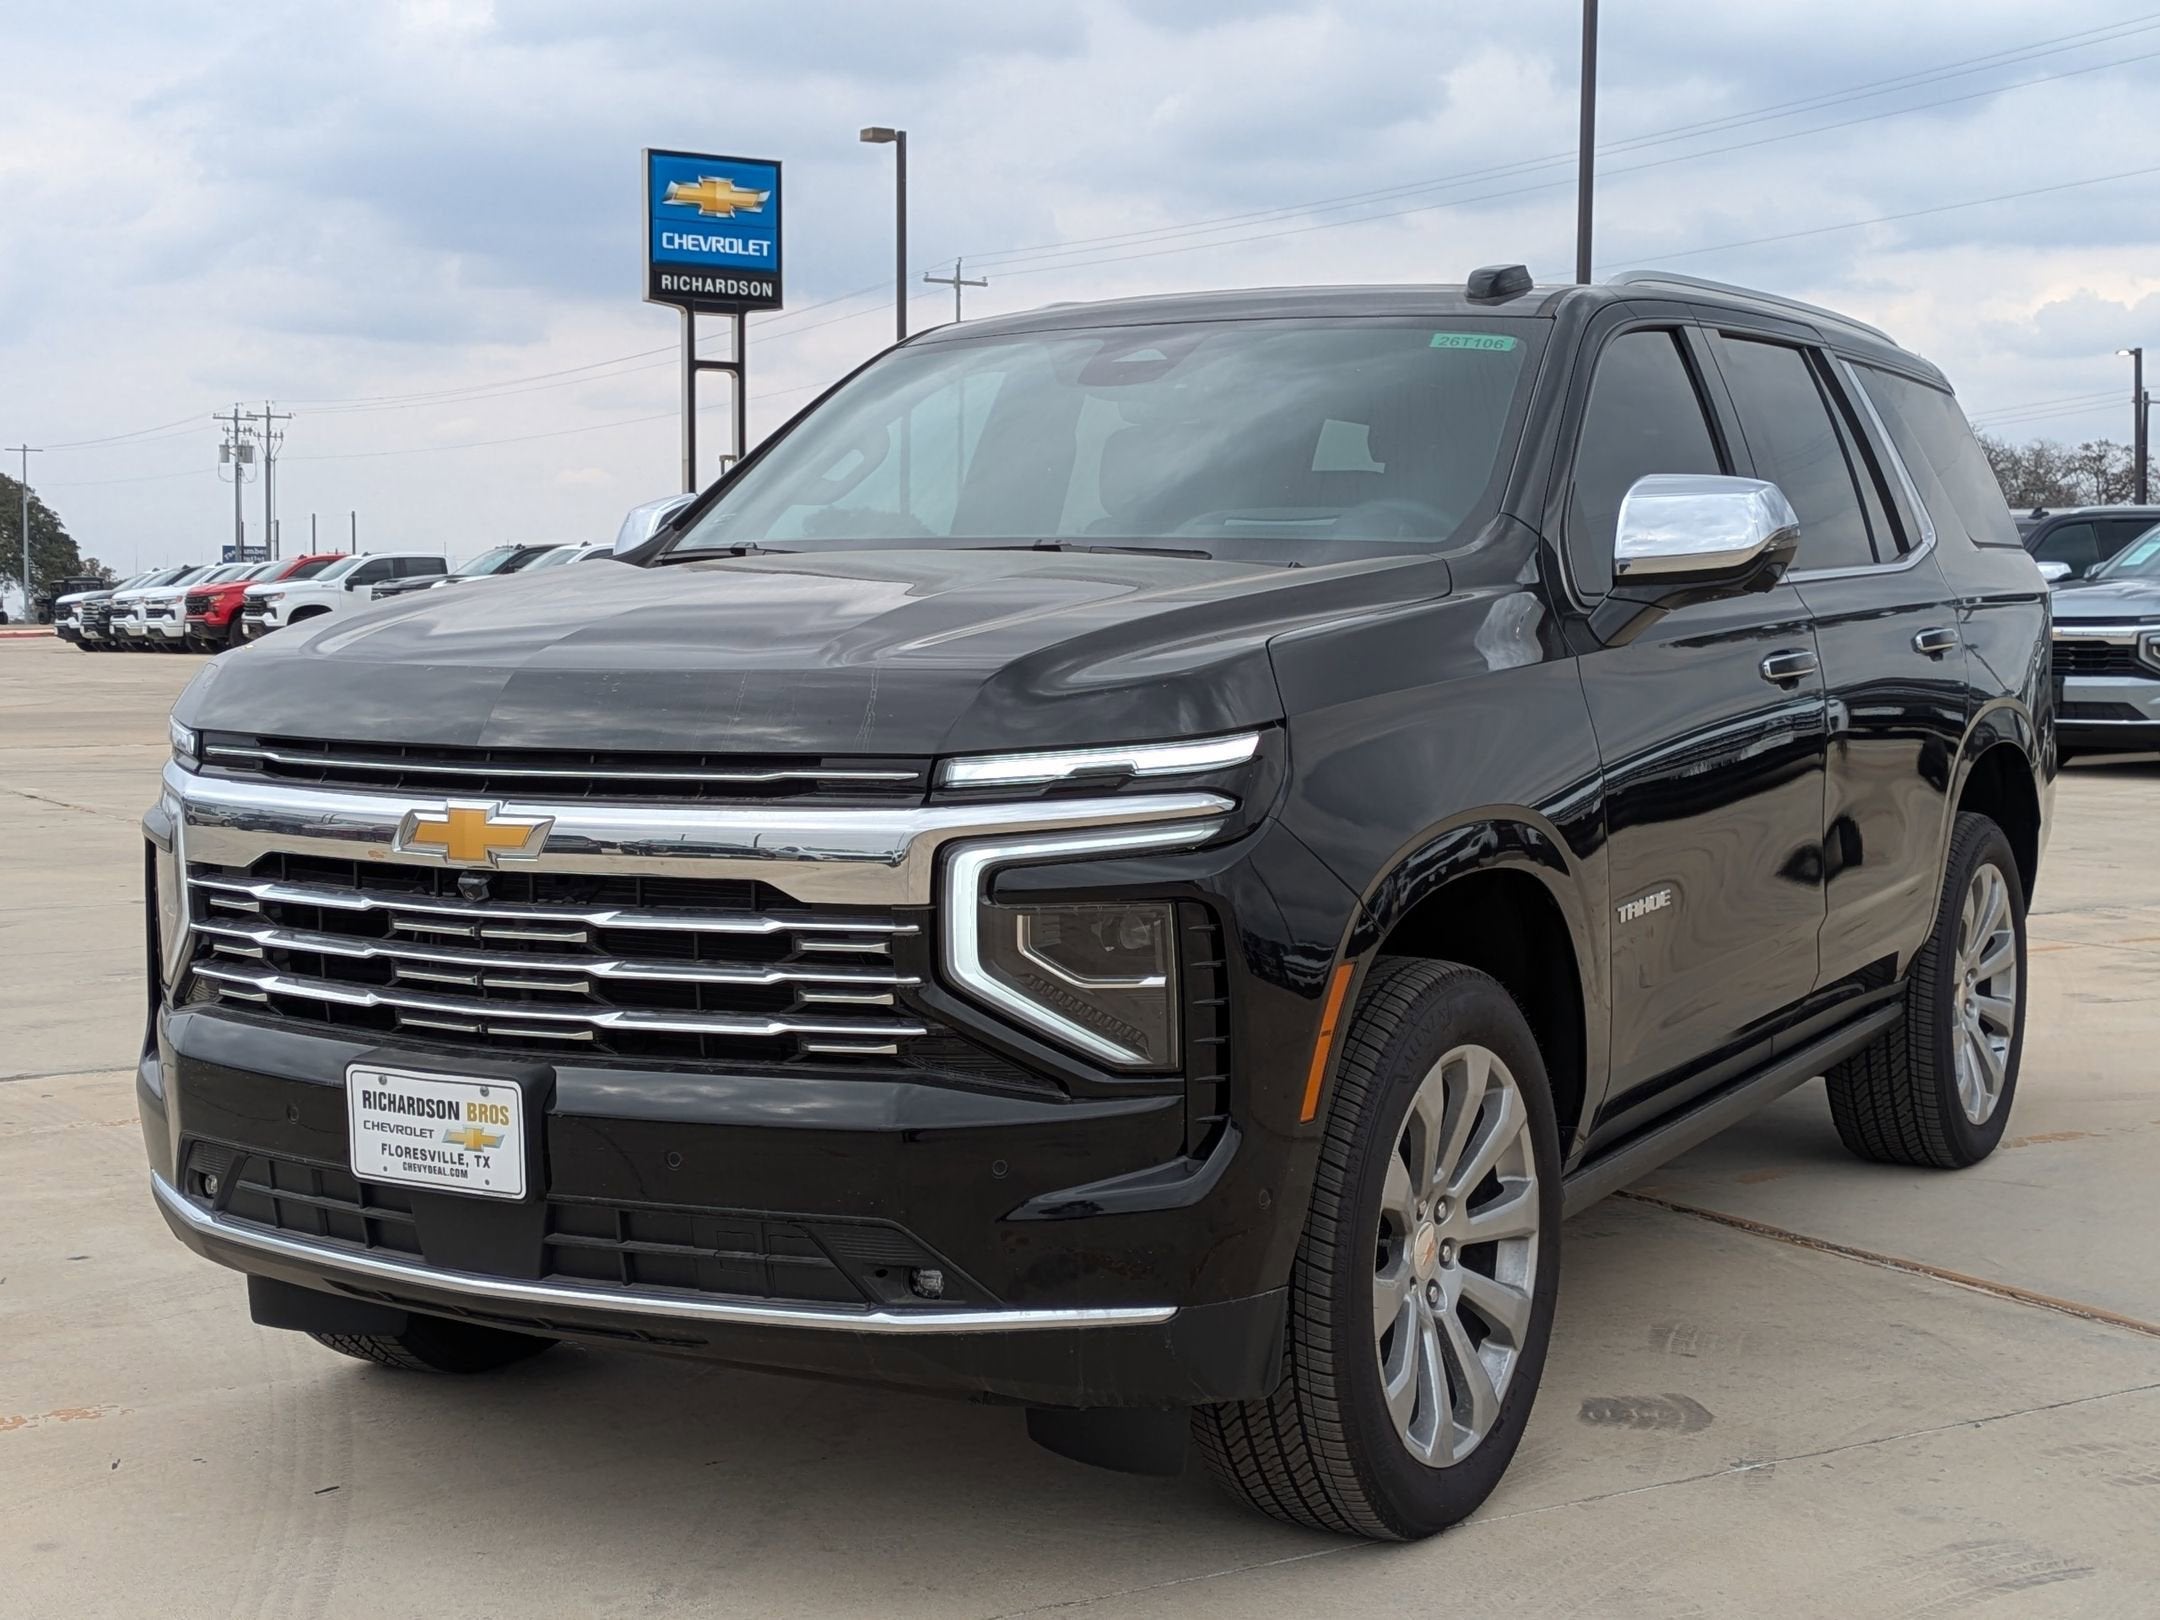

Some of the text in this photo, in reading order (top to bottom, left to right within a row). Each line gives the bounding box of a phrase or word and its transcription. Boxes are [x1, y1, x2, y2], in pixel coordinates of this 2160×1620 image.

[662, 232, 771, 257] CHEVROLET
[661, 274, 773, 297] RICHARDSON
[1438, 336, 1505, 349] 26T106
[1617, 889, 1671, 924] TAHOE
[362, 1090, 510, 1126] RICHARDSON BROS
[363, 1120, 435, 1139] CHEVROLET
[381, 1143, 491, 1169] FLORESVILLE, TX
[402, 1161, 469, 1179] CHEVYDEAL.COM
